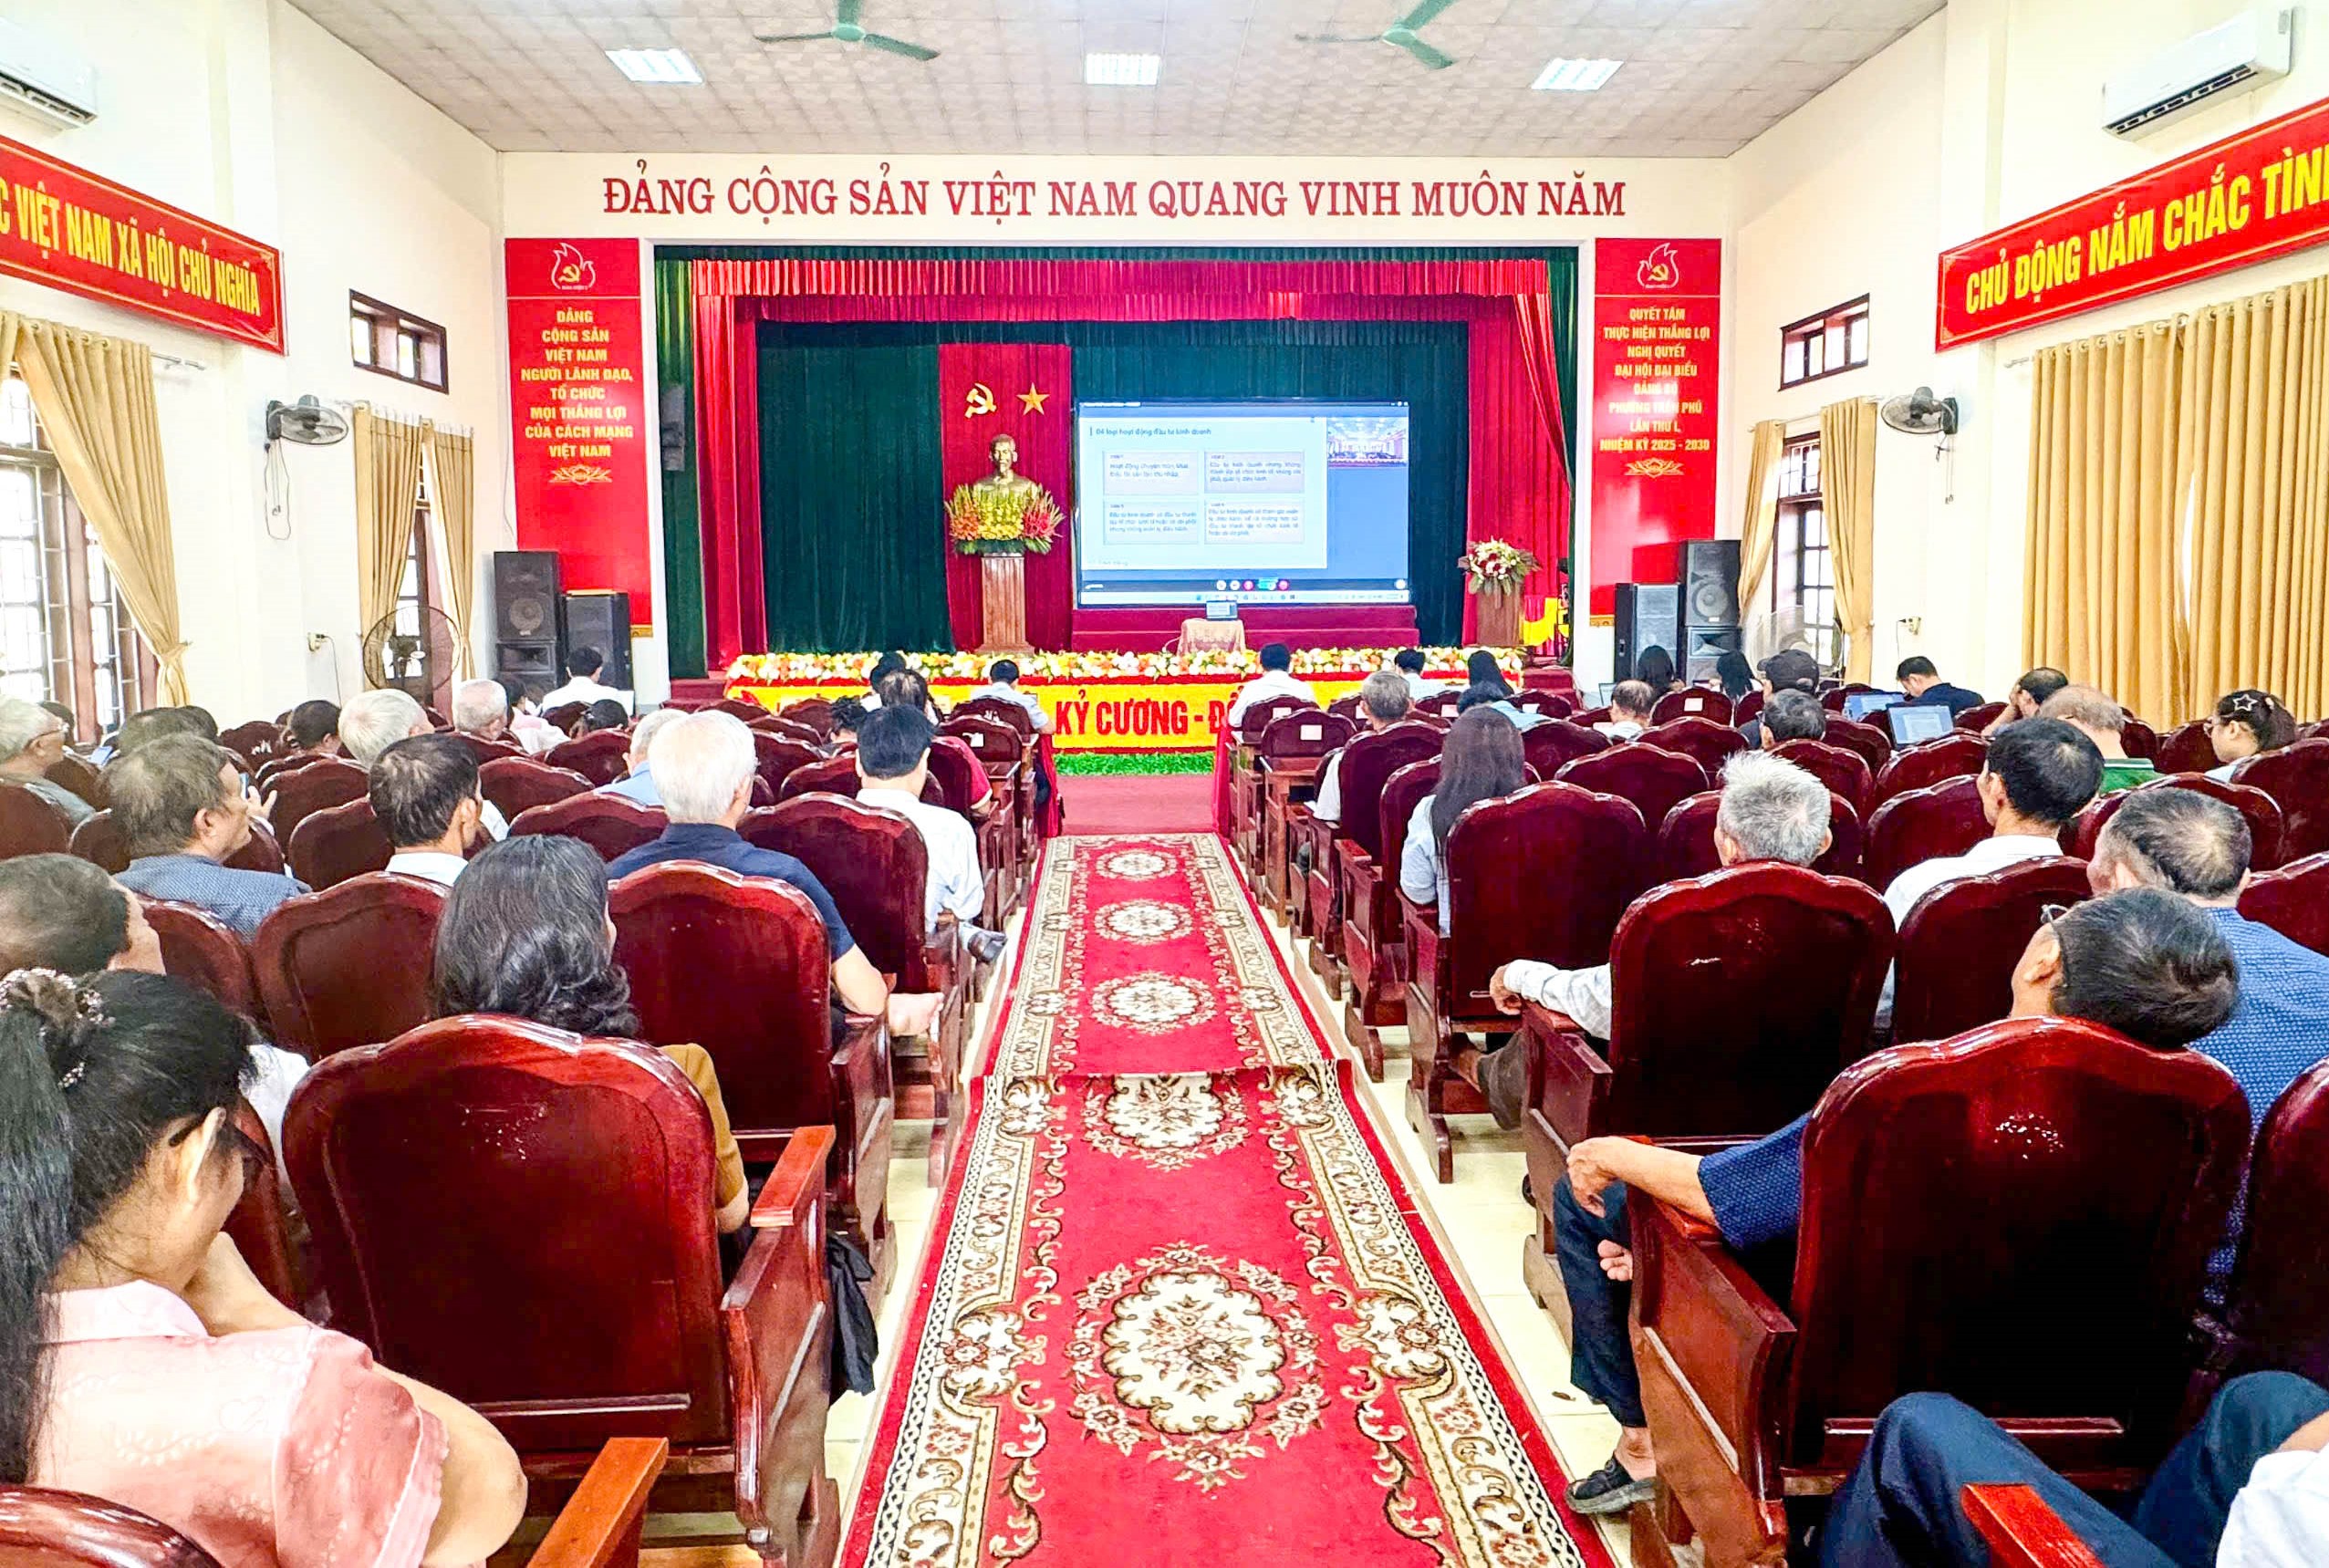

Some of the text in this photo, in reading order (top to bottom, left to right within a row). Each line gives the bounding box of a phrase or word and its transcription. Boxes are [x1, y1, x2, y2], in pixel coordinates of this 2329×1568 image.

[604, 159, 1626, 224] ĐẢNG CỘNG SẢN VIỆT NAM QUANG VINH MUÔN NĂM
[1965, 251, 2008, 315] CHỦ
[2014, 239, 2081, 303] ĐỘNG
[2088, 202, 2154, 275] NẮM
[2163, 163, 2251, 251] CHẮC
[15, 181, 59, 259] VIỆT
[65, 202, 113, 268] NAM
[117, 217, 143, 278] XÃ
[145, 227, 176, 296] HỘI
[179, 238, 212, 300] CHỦ
[213, 257, 261, 317] NGHĨA
[556, 307, 593, 323] ĐẢNG
[542, 327, 609, 344] CỘNG SẢN
[546, 348, 608, 363] VIỆT NAM
[1682, 400, 1702, 413] PHÚ
[525, 423, 633, 440] CỦA CÁCH MẠNG
[549, 444, 610, 460] VIỆT NAM
[1600, 437, 1633, 453] NHIỆM
[1651, 440, 1676, 451] 2025
[1685, 440, 1710, 451] 2030
[1055, 690, 1089, 735] KỶ
[1097, 698, 1188, 735] CƯƠNG
